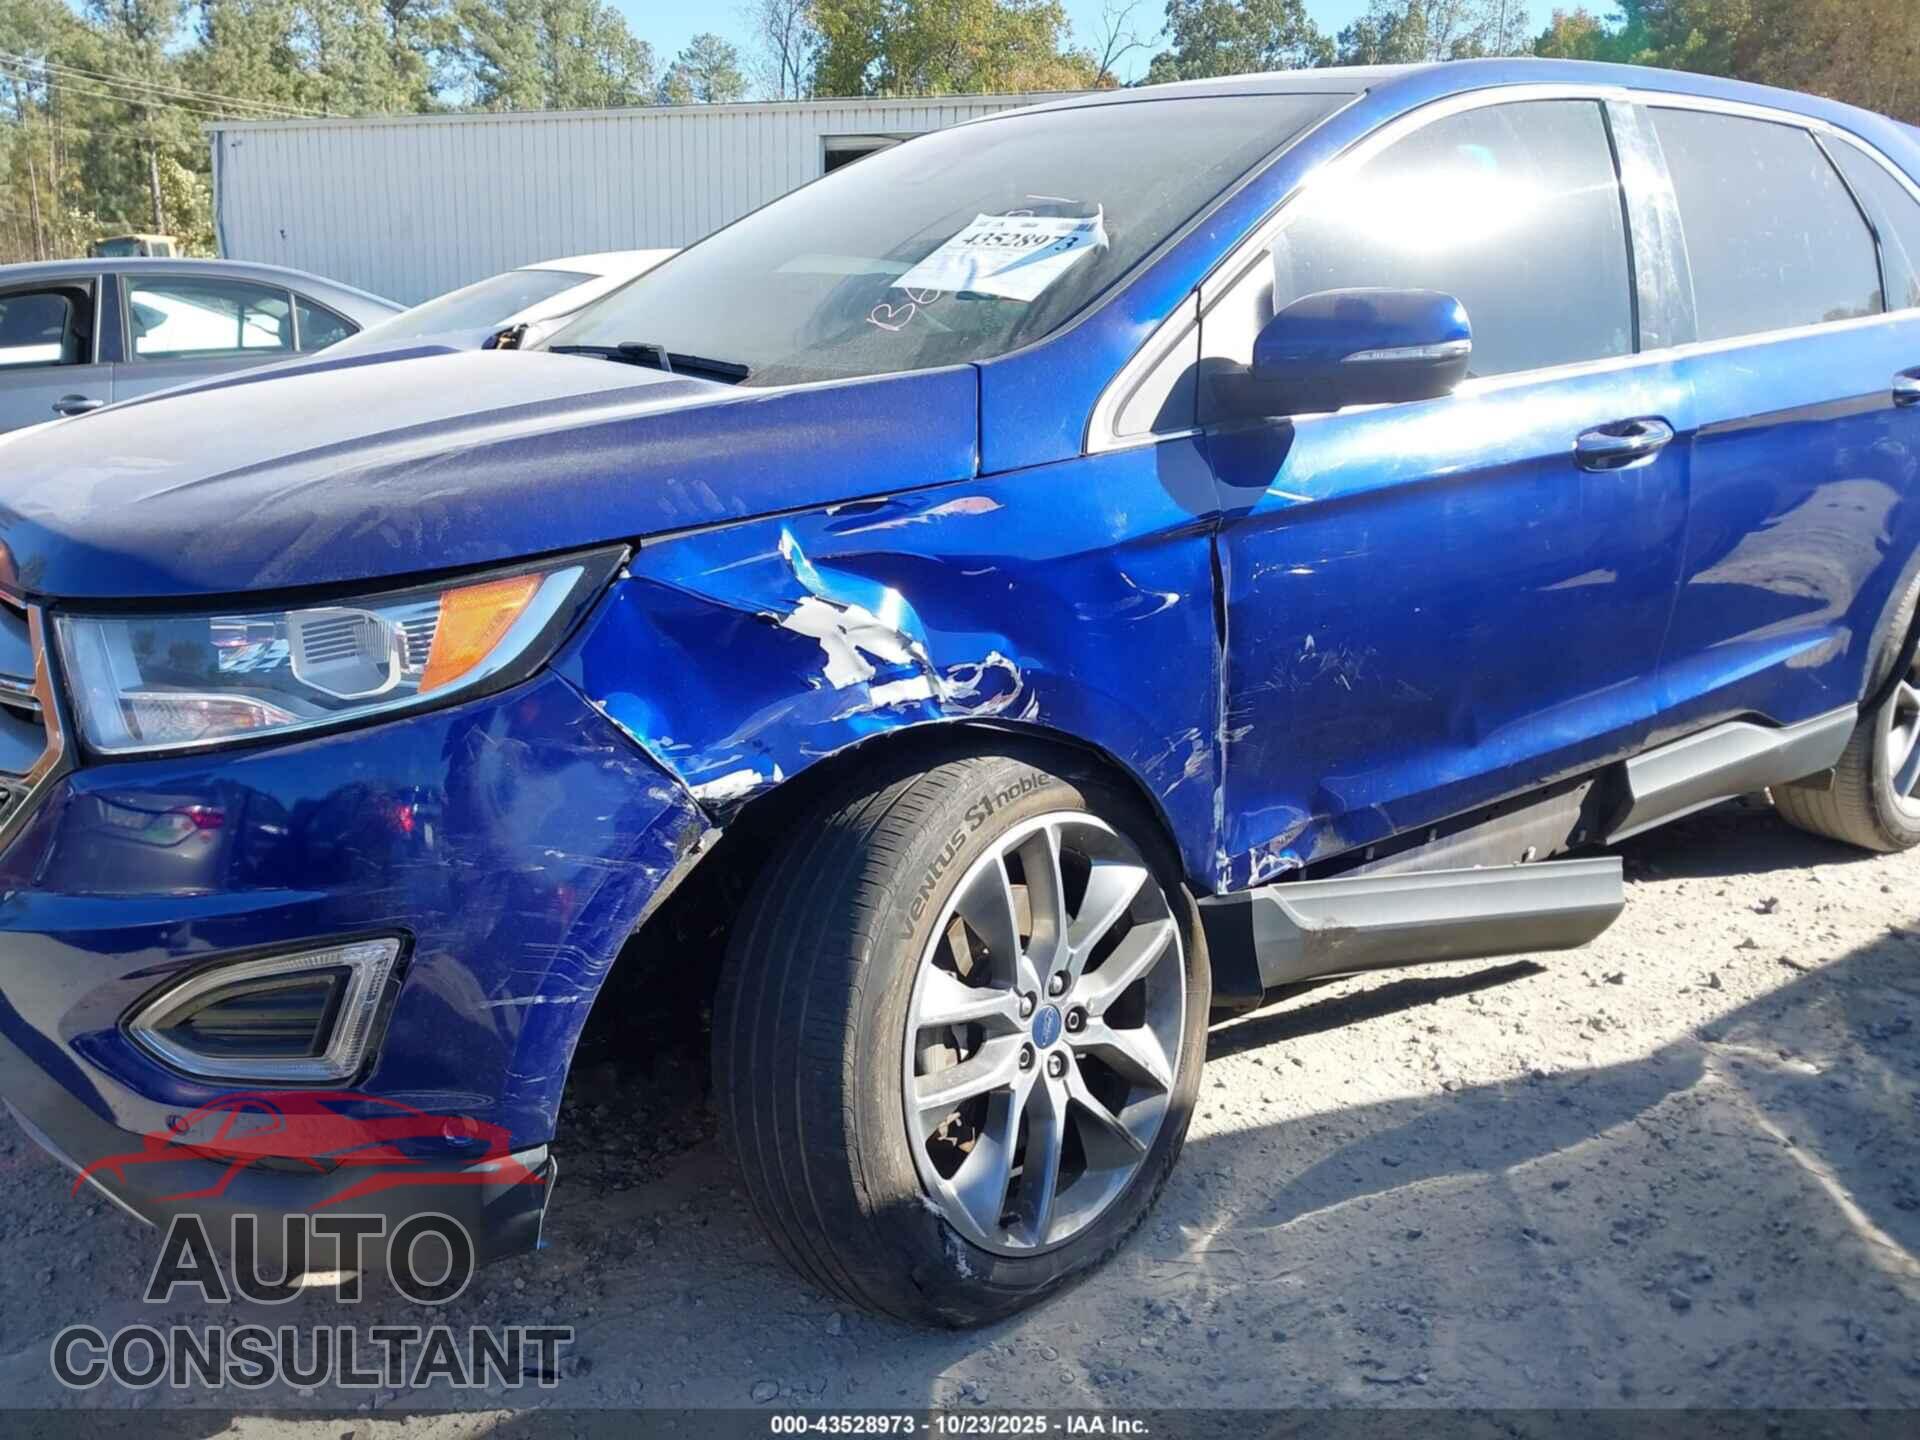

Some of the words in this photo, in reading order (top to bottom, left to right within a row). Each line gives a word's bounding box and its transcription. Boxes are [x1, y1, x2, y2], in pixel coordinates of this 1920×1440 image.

[961, 231, 1080, 252] 43528973
[964, 795, 995, 833] S1
[992, 773, 1052, 809] noble
